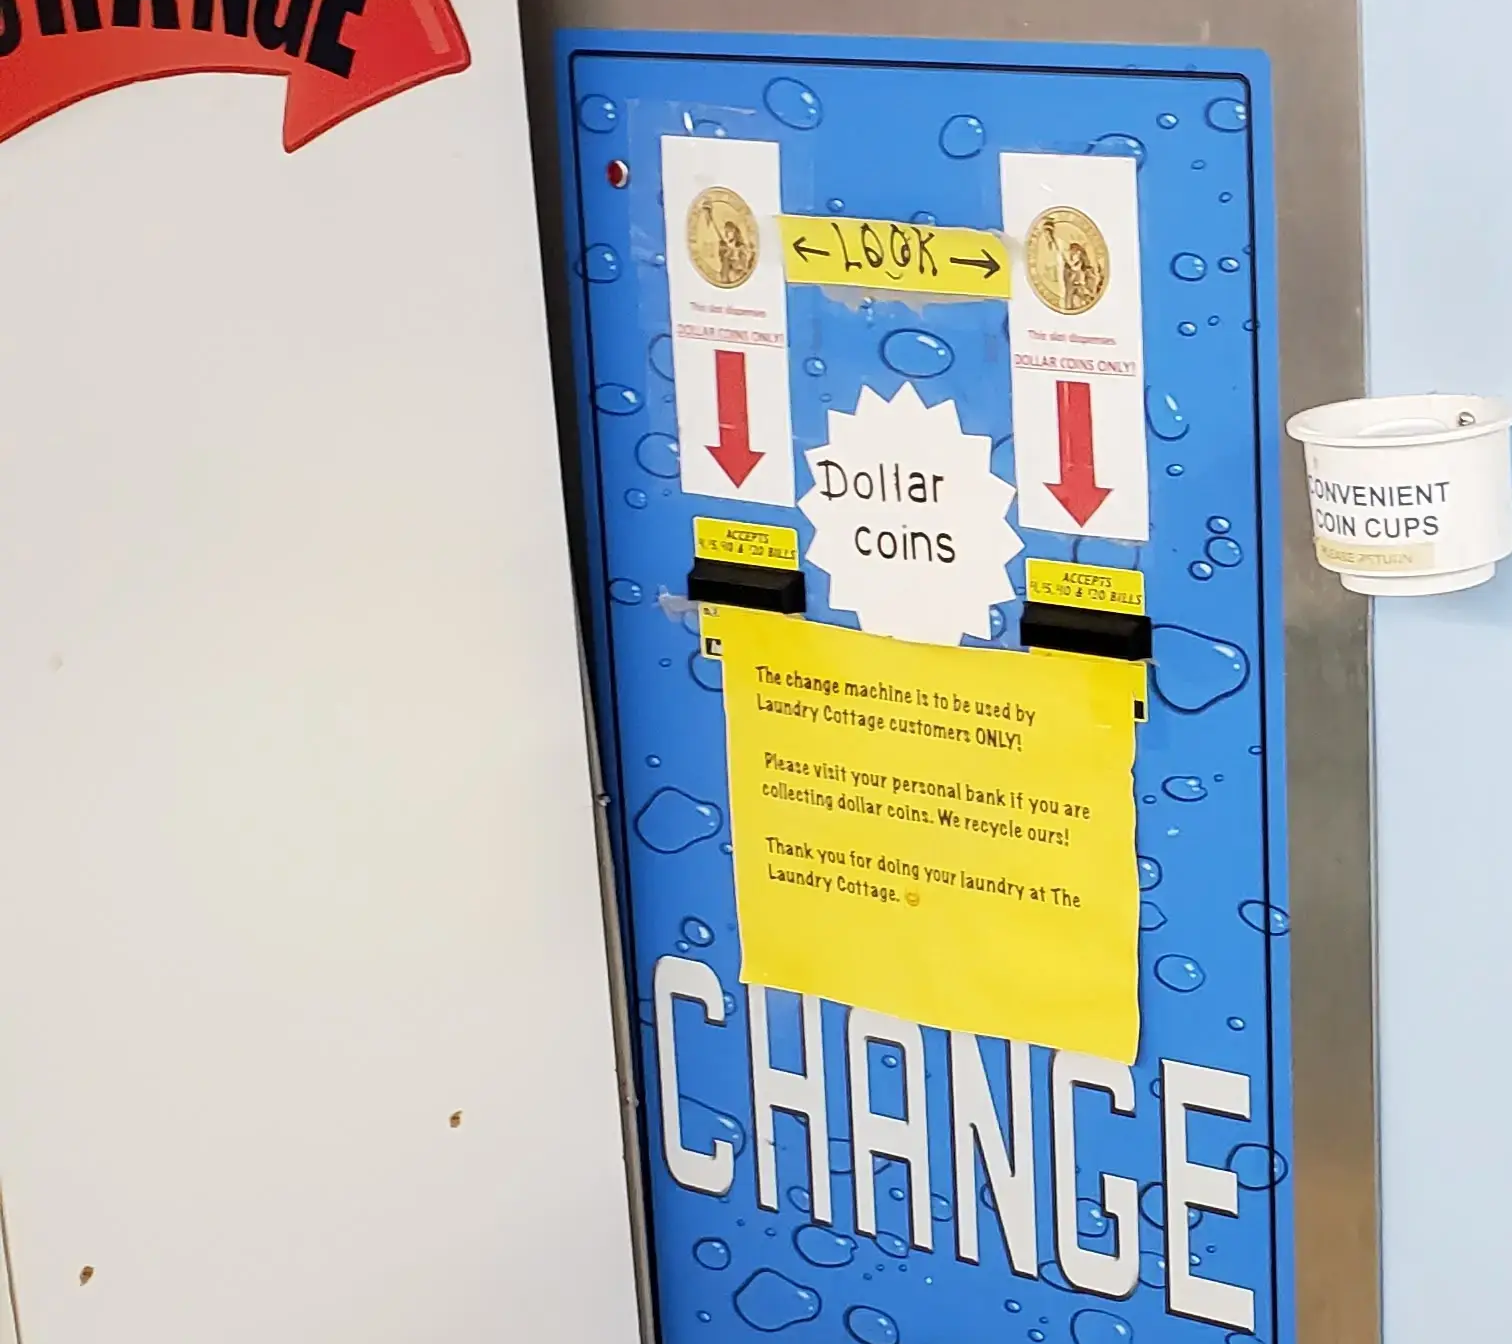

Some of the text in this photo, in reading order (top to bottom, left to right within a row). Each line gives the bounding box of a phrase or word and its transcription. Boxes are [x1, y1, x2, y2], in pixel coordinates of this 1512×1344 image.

[832, 224, 939, 280] LOOK
[817, 461, 945, 504] Dollar
[855, 524, 956, 564] coins
[1315, 508, 1439, 538] COIN CUPS
[1063, 573, 1112, 588] ACCEPTS
[756, 666, 1036, 726] The change machine is to be used by
[756, 693, 1023, 752] Laundry Cottage customers ONLY!
[761, 781, 1070, 847] collecting dollar coins. We recycle ours!
[765, 752, 1091, 820] Please visit your personal bank if you are
[765, 836, 1082, 909] Thank you for doing your laundry at The
[767, 863, 901, 904] Laundry Cottage.
[654, 954, 1256, 1334] CHANGE
